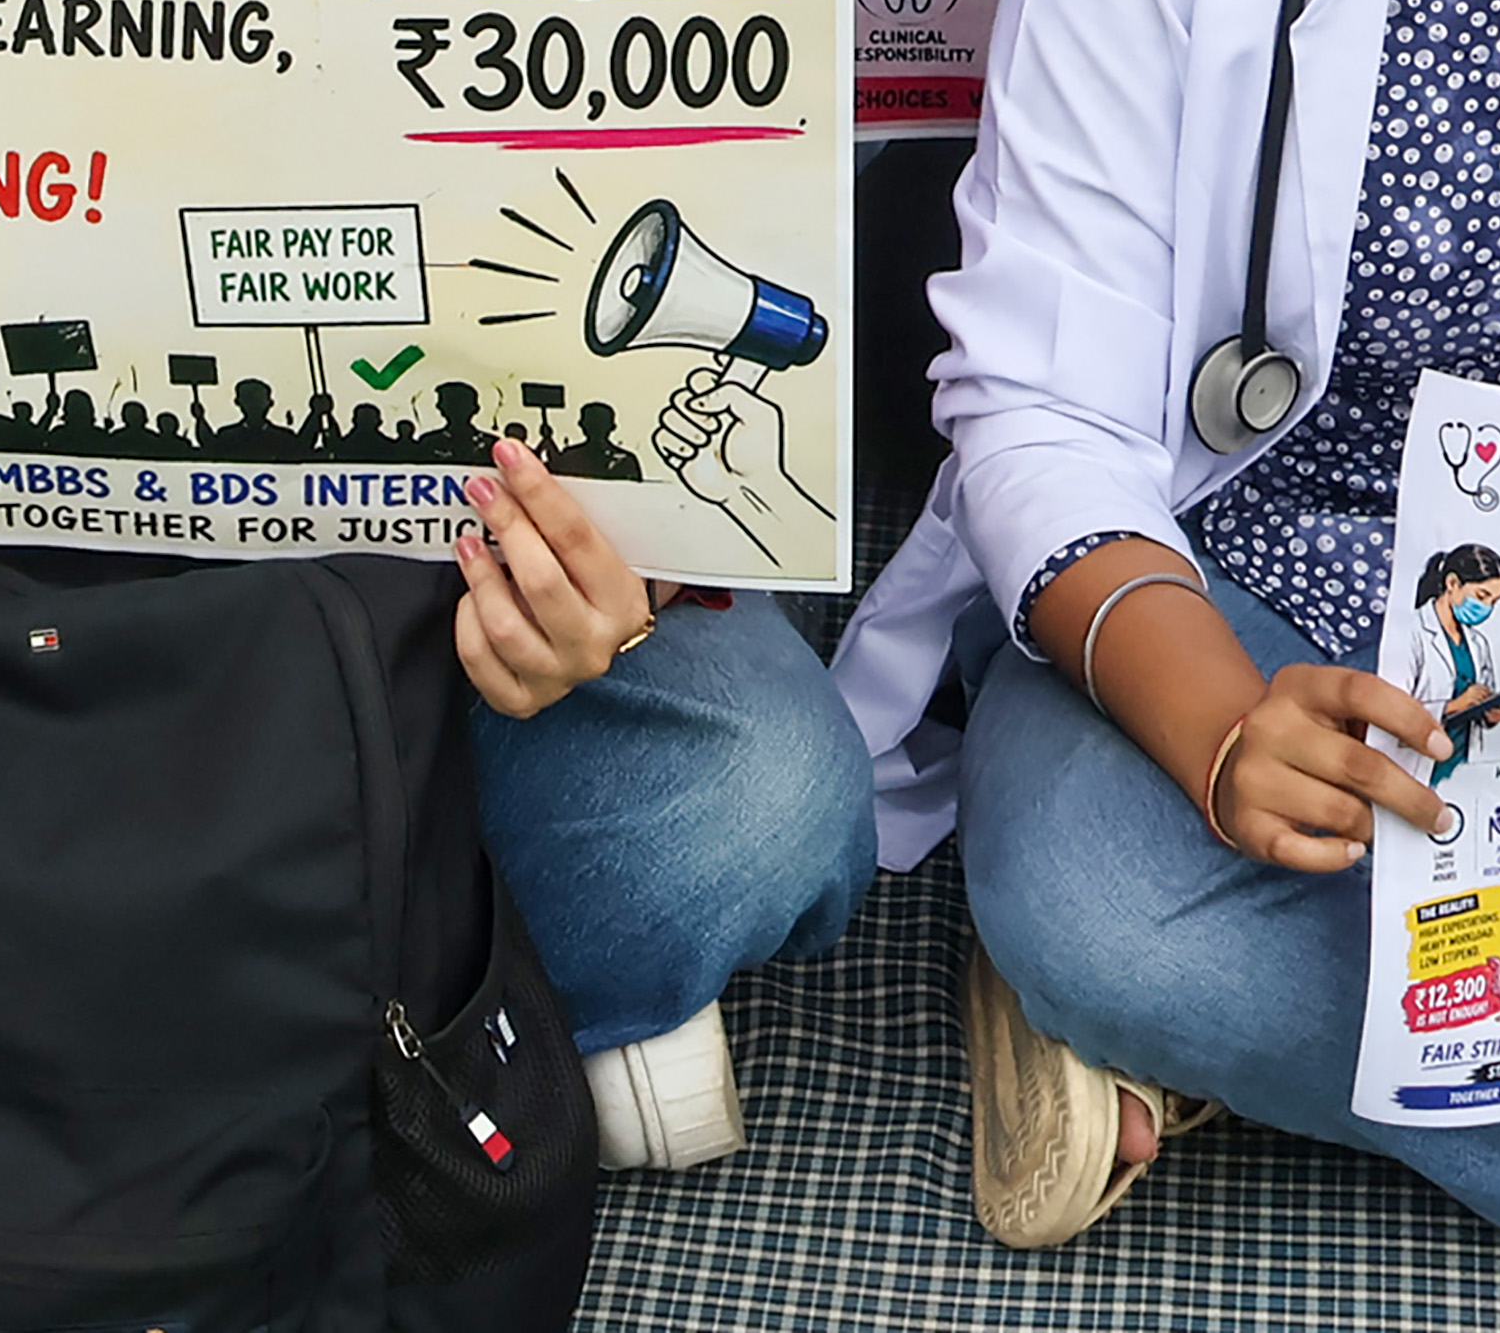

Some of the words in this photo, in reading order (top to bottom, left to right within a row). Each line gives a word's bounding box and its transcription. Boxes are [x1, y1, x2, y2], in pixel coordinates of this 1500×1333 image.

[392, 13, 790, 123] ₹30,000
[209, 228, 275, 262] FAIR
[280, 226, 331, 260] PAY
[339, 224, 395, 258] FOR
